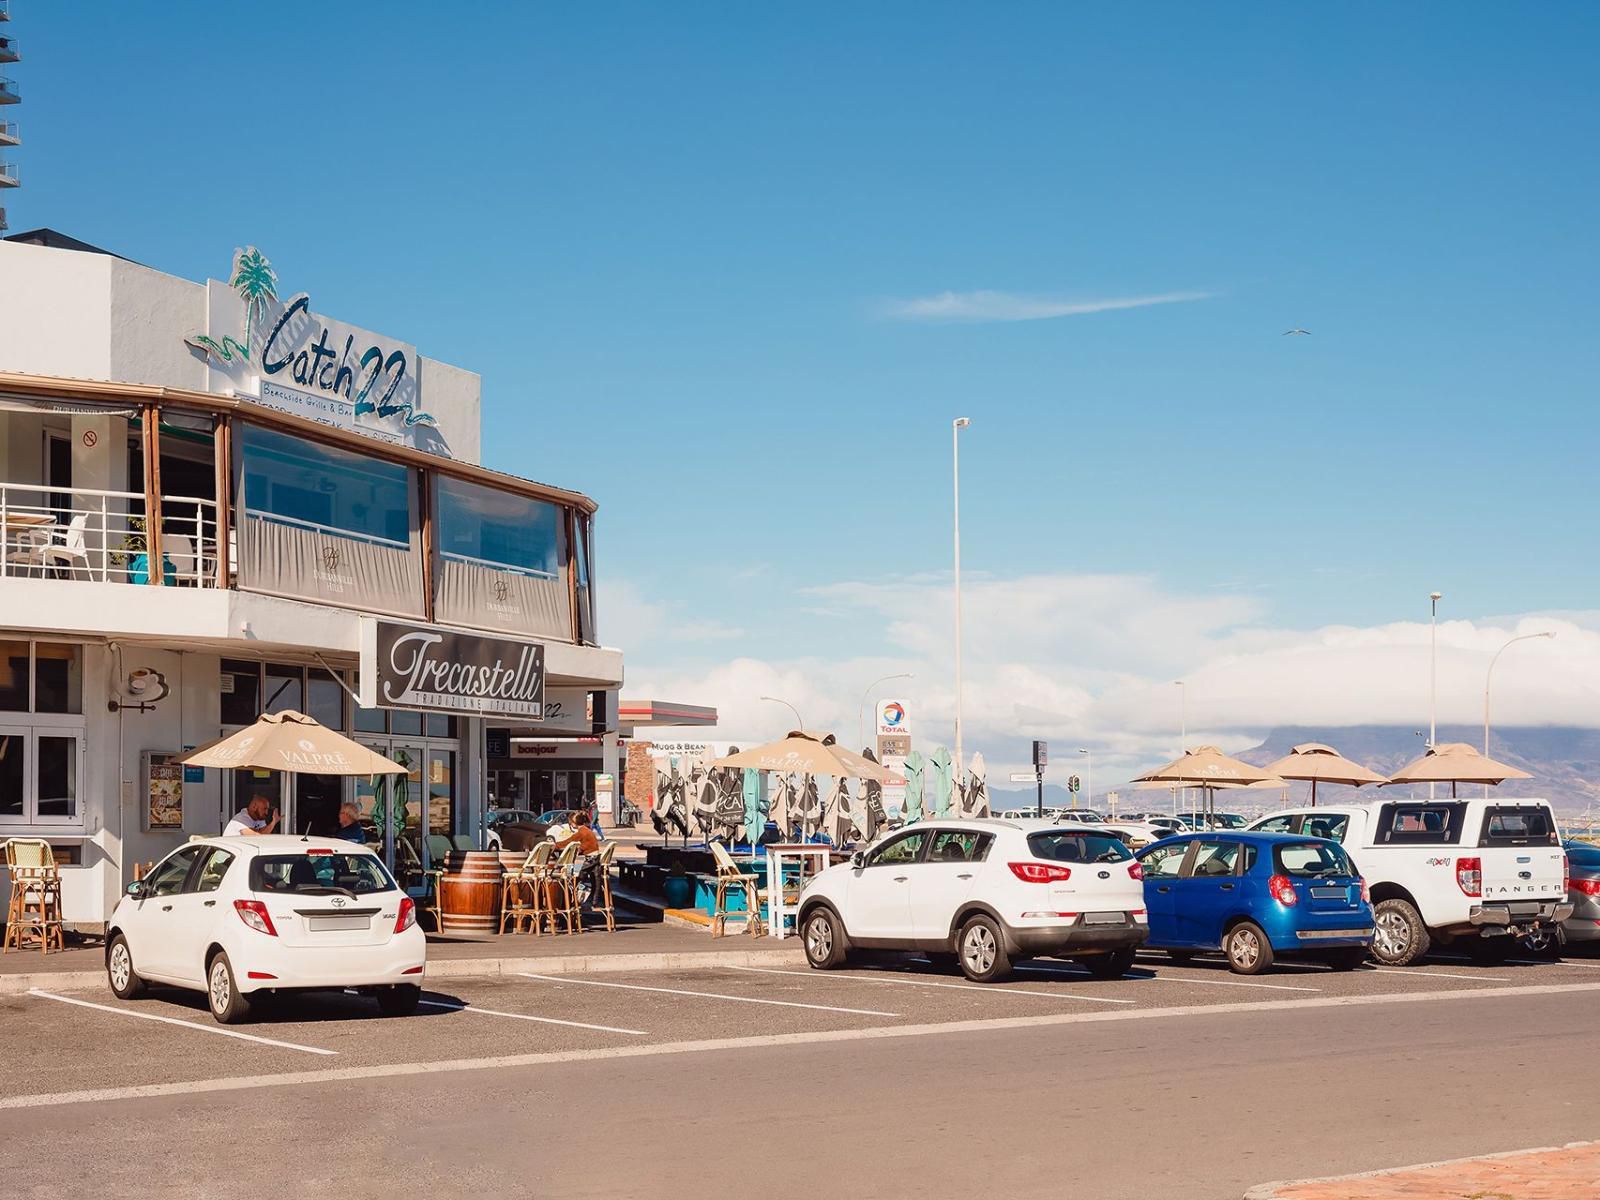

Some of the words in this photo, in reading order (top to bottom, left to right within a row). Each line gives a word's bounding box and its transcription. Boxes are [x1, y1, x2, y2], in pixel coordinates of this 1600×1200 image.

[383, 631, 541, 704] Trecastelli
[415, 692, 482, 709] TRADIZIONE
[880, 725, 908, 734] TOTAL
[518, 745, 559, 756] bonjour
[1485, 884, 1562, 894] RANGER
